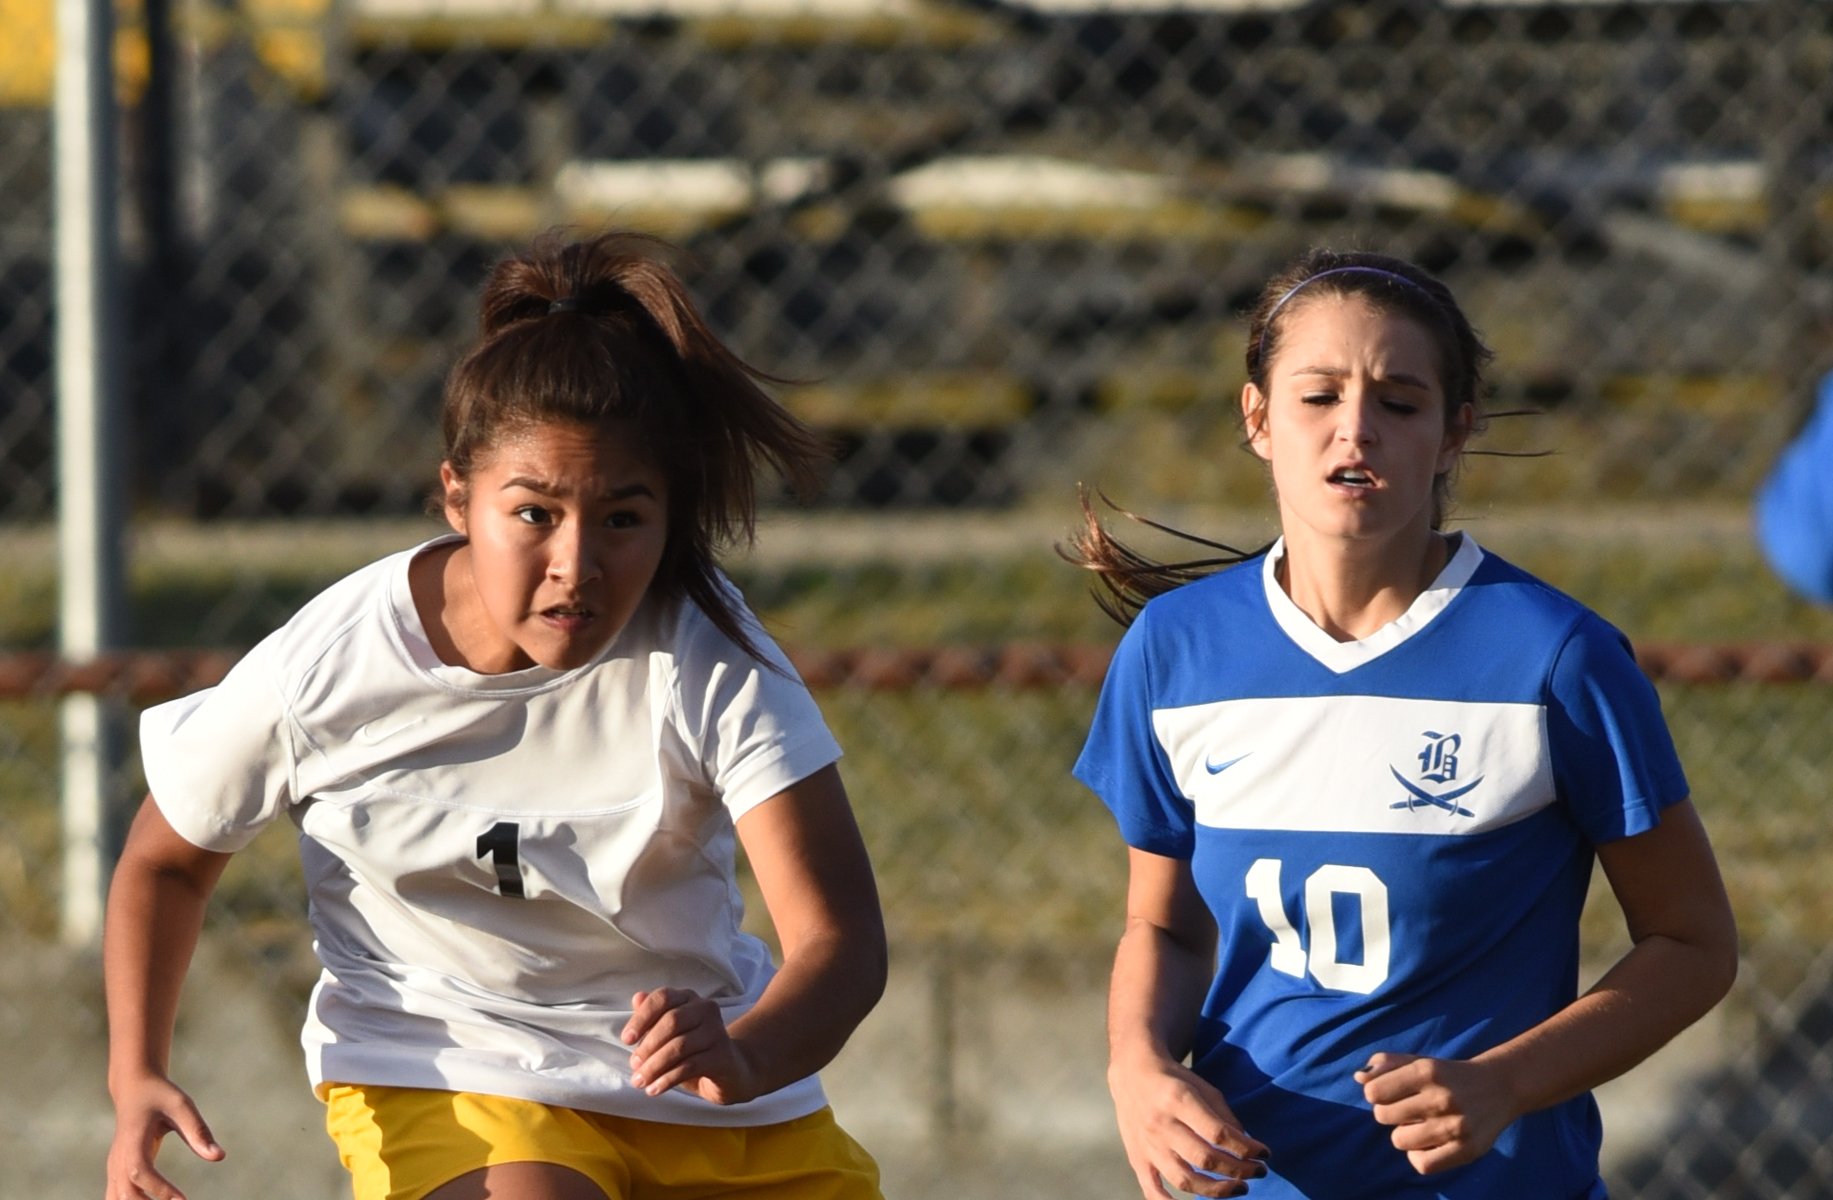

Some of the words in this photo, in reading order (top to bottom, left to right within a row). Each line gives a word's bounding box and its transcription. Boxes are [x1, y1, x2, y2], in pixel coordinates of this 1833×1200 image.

[1417, 730, 1461, 783] B
[476, 821, 525, 899] 1
[1245, 858, 1391, 994] 10
